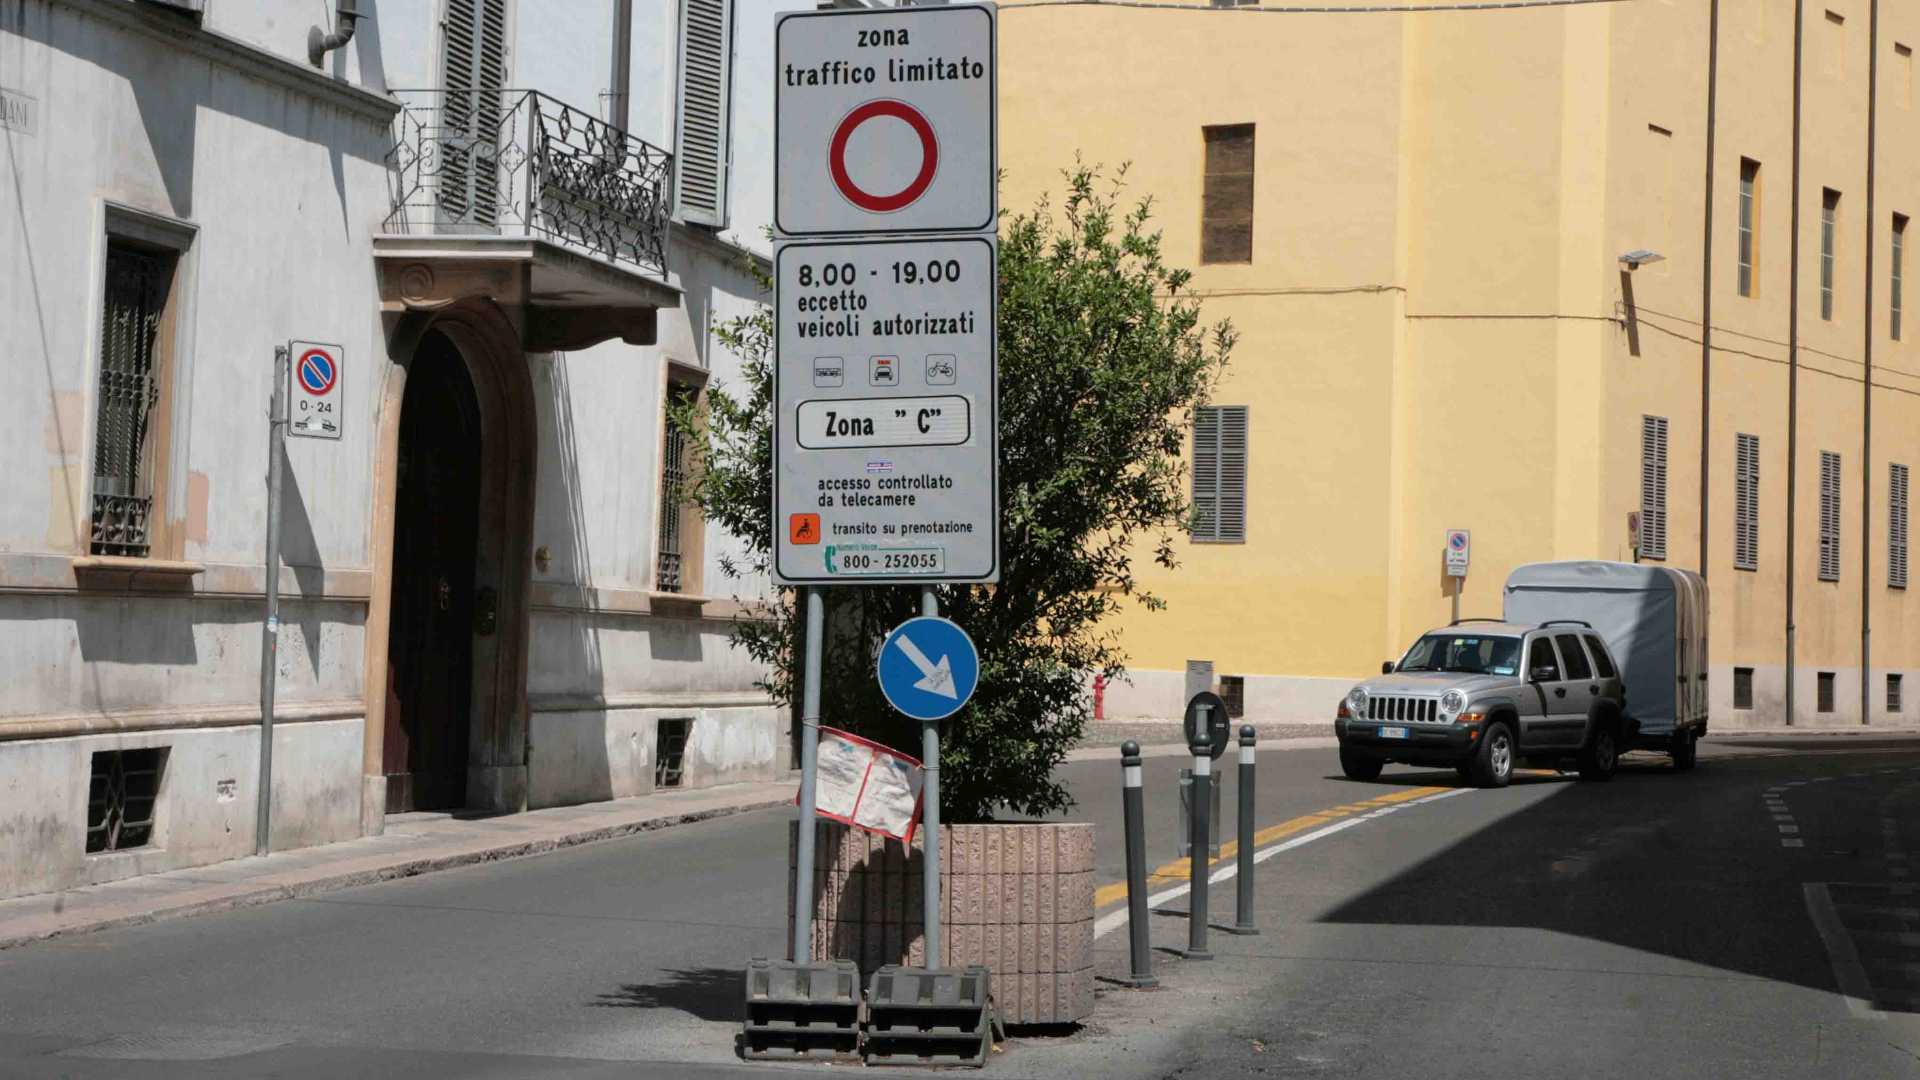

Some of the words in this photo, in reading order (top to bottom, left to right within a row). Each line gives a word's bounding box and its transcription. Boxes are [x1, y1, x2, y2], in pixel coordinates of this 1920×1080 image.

[857, 28, 910, 47] zona
[785, 60, 876, 87] traffico
[889, 56, 984, 82] limitato
[798, 262, 856, 288] 8,00
[892, 259, 961, 285] 19,00
[798, 289, 867, 312] eccetto
[797, 314, 860, 338] veicoli
[872, 311, 975, 336] autorizzati
[825, 411, 875, 437] Zona
[818, 478, 871, 491] accesso
[878, 474, 953, 490] controllato
[818, 494, 834, 507] da
[841, 492, 916, 507] telecamere
[832, 522, 878, 536] transito
[883, 524, 895, 534] su
[901, 520, 973, 537] prenotazione
